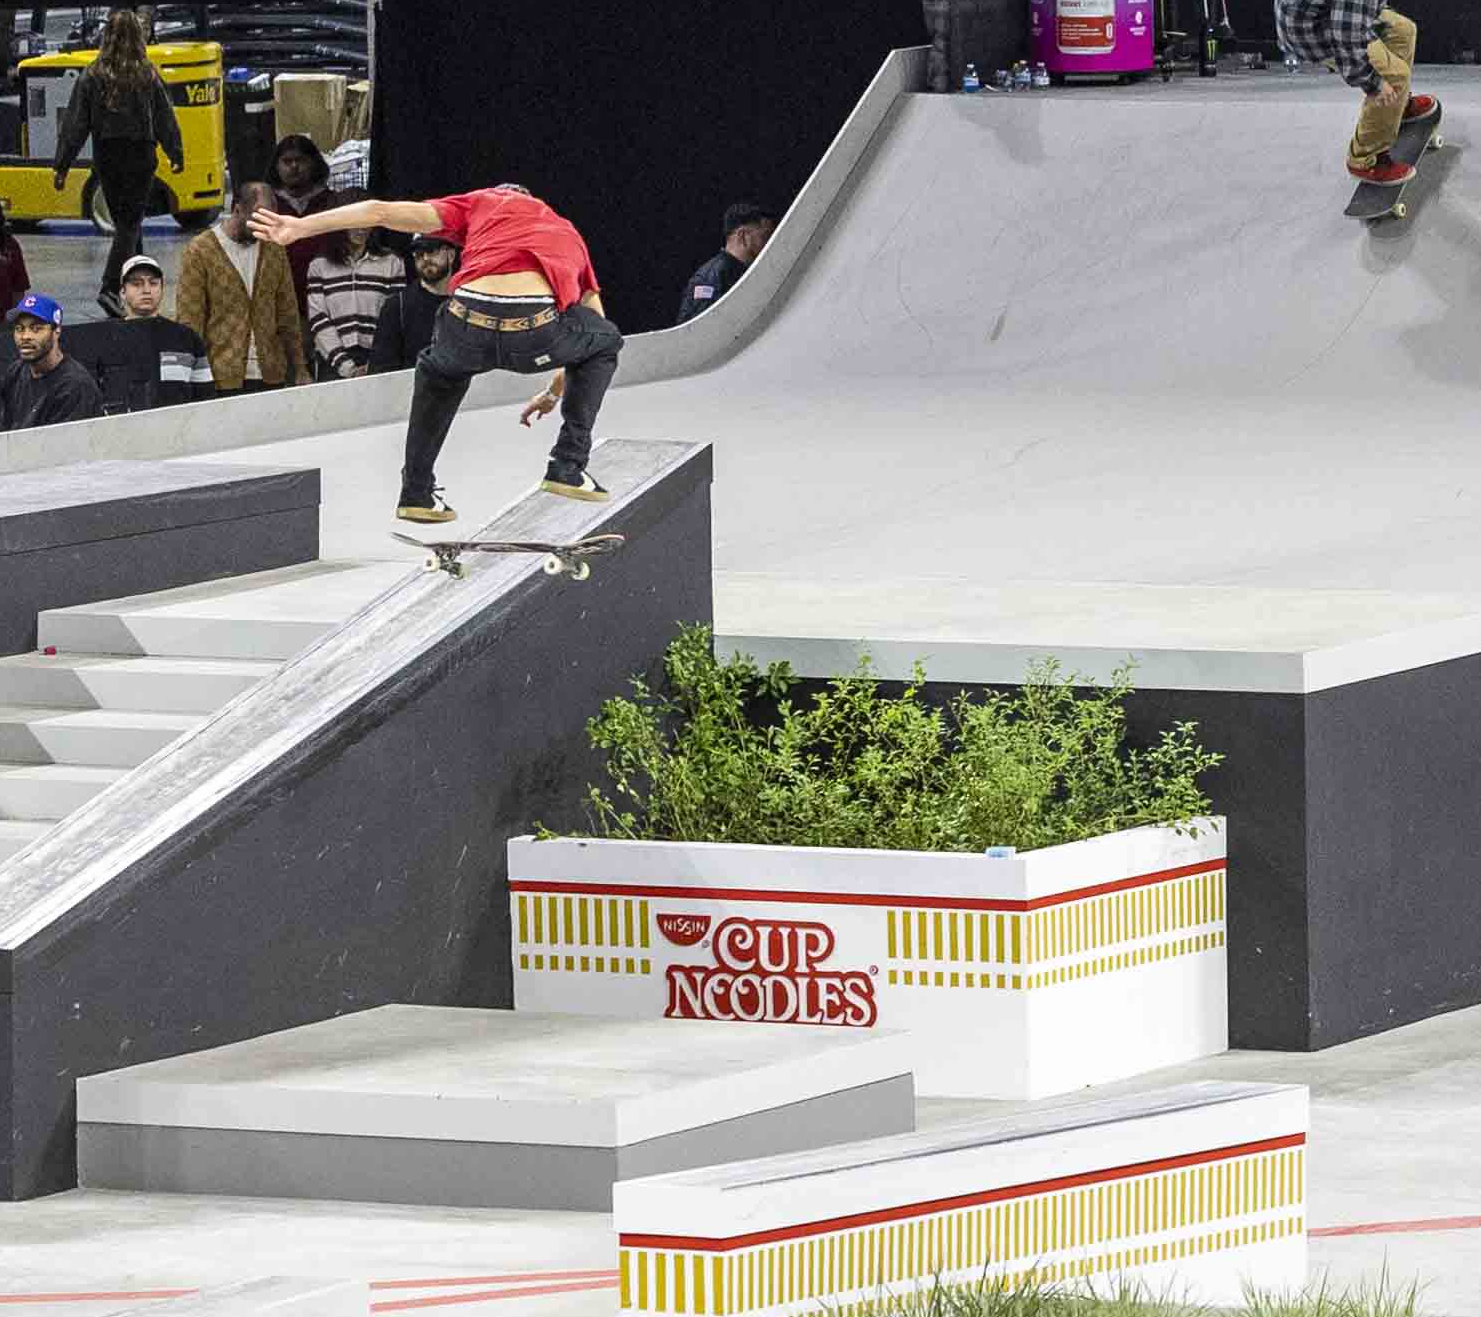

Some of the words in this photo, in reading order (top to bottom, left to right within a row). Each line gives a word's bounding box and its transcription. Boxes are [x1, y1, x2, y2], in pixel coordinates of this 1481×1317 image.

[662, 919, 706, 936] NISSIN
[718, 922, 829, 973] CUP
[667, 973, 874, 1027] NOODLES
